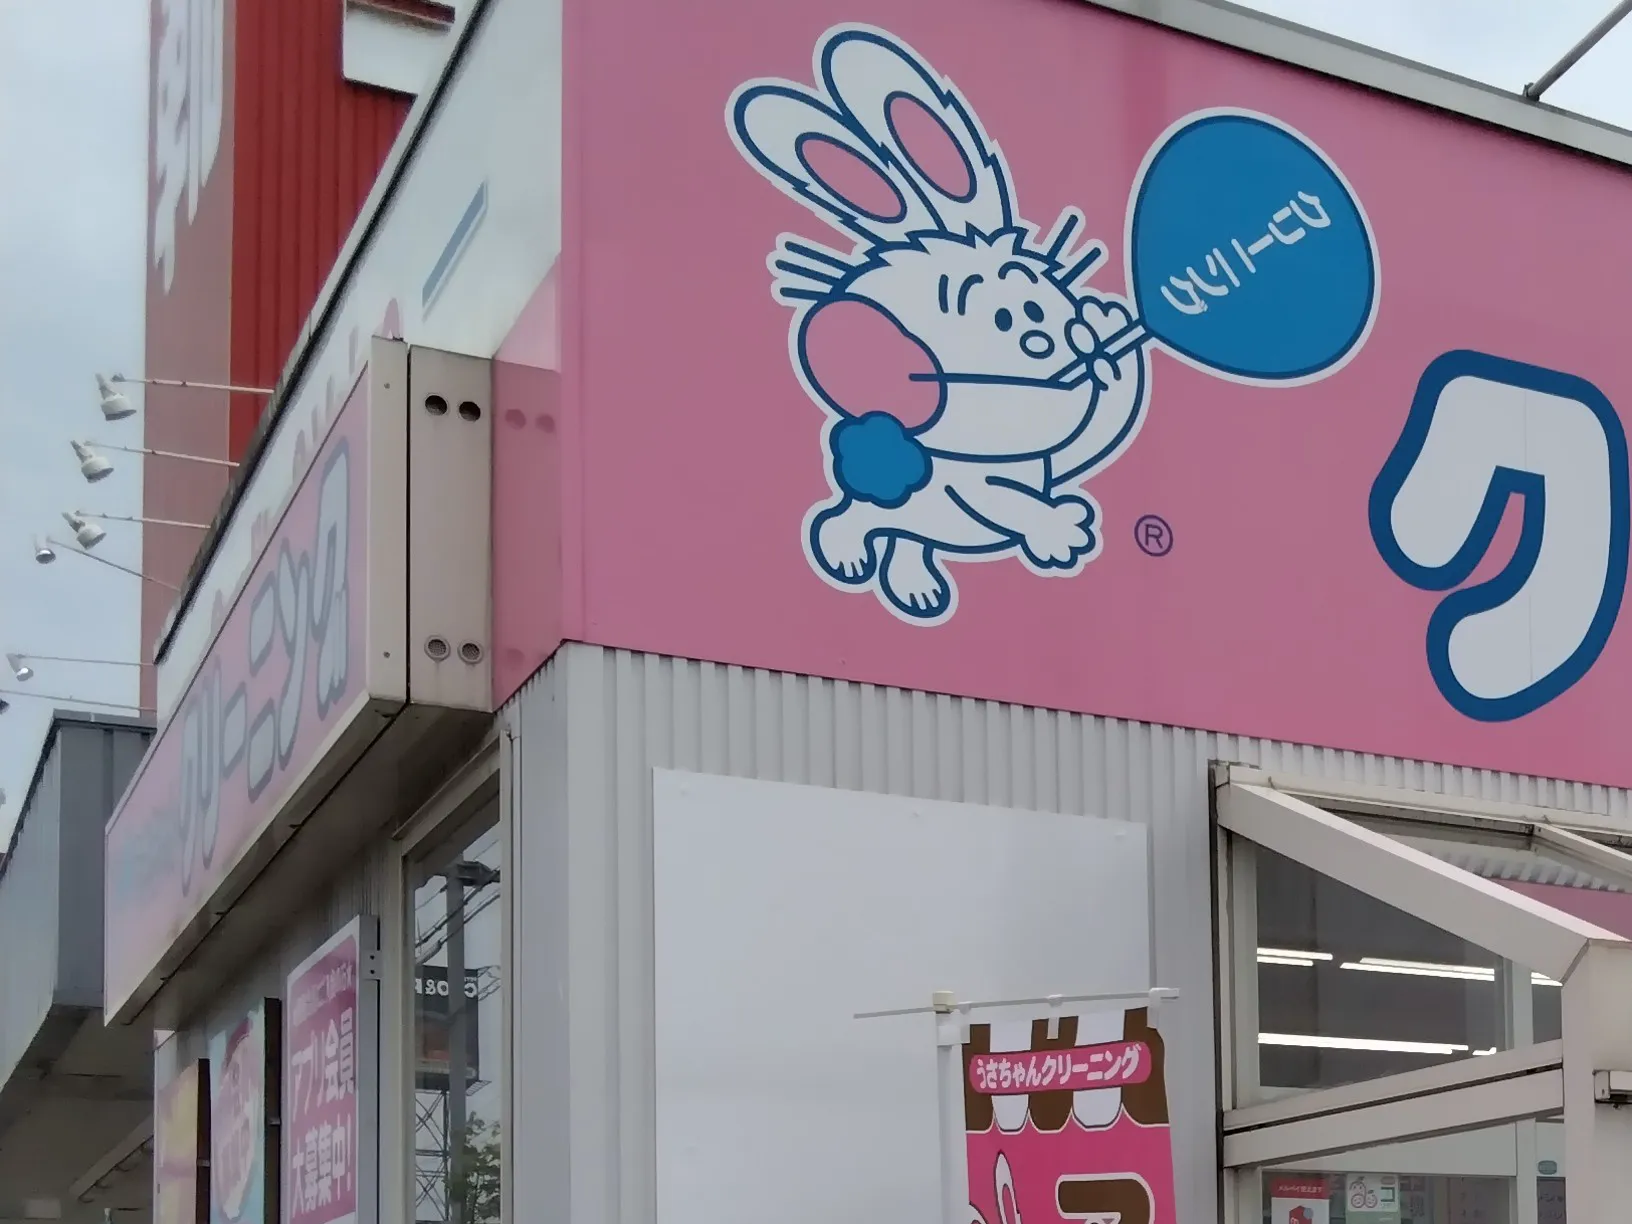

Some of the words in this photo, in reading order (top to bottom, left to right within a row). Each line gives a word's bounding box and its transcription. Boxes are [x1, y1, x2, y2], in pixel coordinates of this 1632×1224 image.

[975, 1044, 1142, 1090] うさちゃんクリーニング
